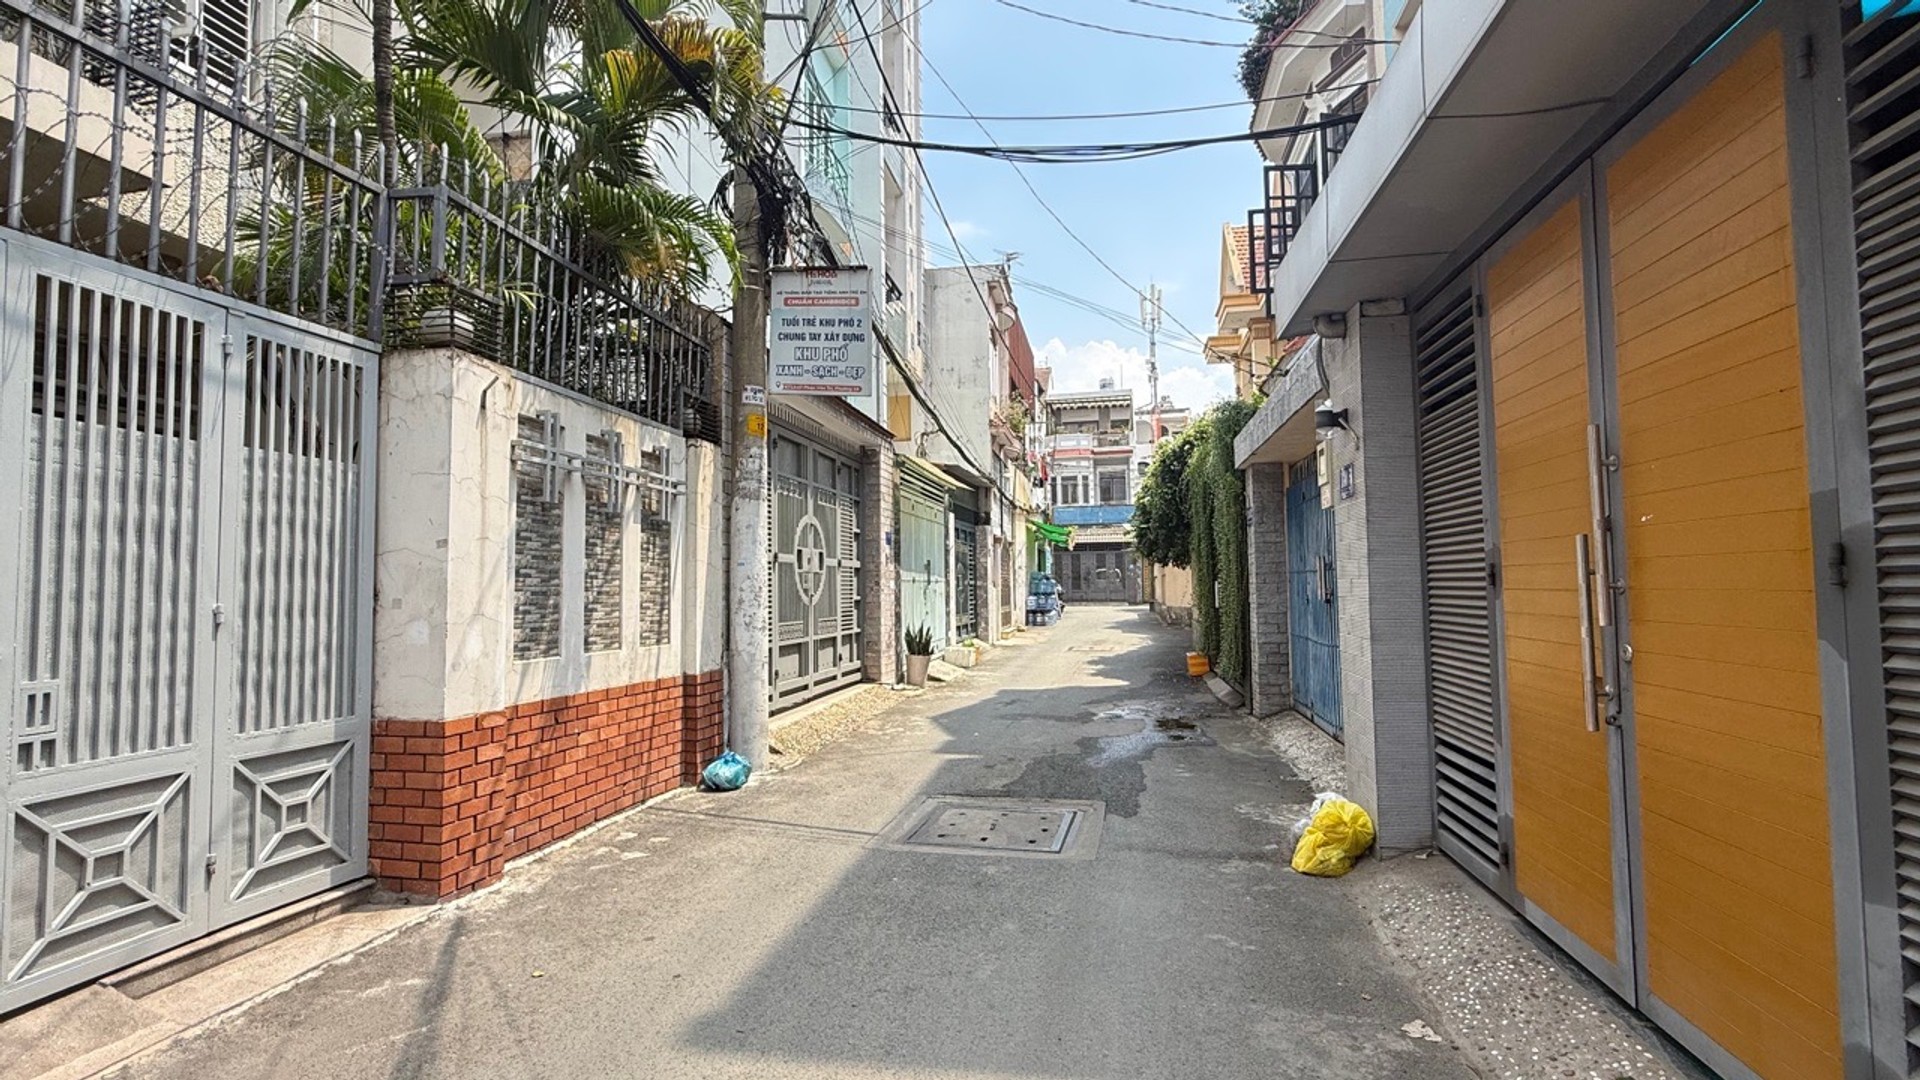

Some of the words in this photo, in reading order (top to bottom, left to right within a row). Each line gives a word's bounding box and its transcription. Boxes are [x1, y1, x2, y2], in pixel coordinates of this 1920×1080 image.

[781, 315, 800, 327] TUỔI
[802, 315, 817, 327] TRẺ
[819, 318, 836, 327] KHU
[838, 315, 855, 328] PHỐ
[856, 319, 863, 328] 2
[777, 332, 806, 342] CHUNG
[808, 332, 821, 341] TAY
[823, 331, 840, 342] XÂY
[842, 333, 866, 343] DỰNG
[794, 346, 820, 361] KHU
[822, 342, 849, 362] PHỐ
[776, 364, 803, 377] XANH
[811, 365, 838, 379] SẠCH
[845, 366, 866, 380] ĐẸP
